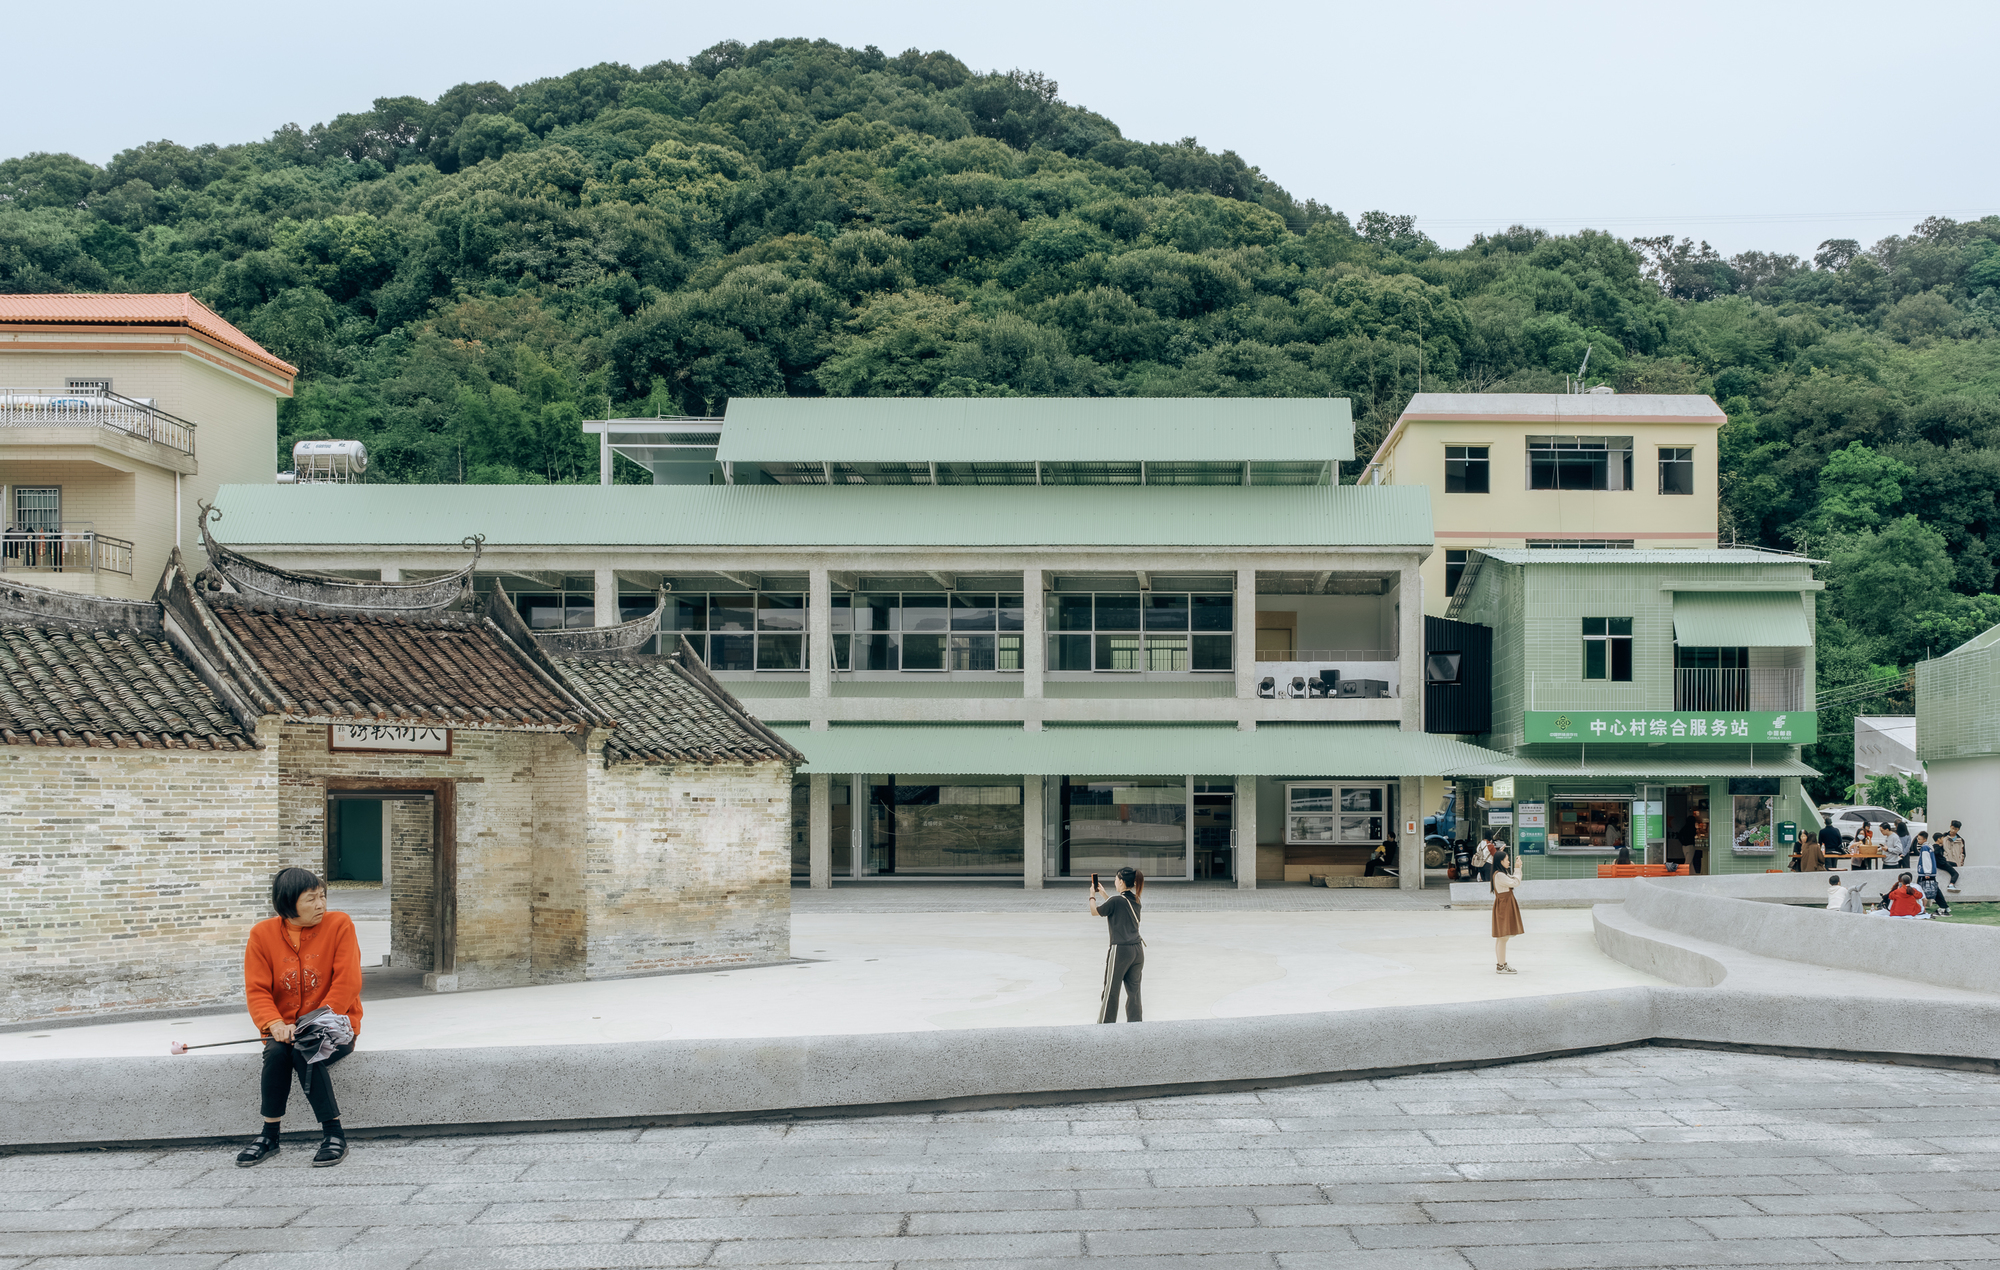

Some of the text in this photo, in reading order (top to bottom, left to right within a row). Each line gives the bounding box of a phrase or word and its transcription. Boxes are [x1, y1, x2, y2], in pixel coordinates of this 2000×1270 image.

[1590, 718, 1748, 737] 中心村综合服务站
